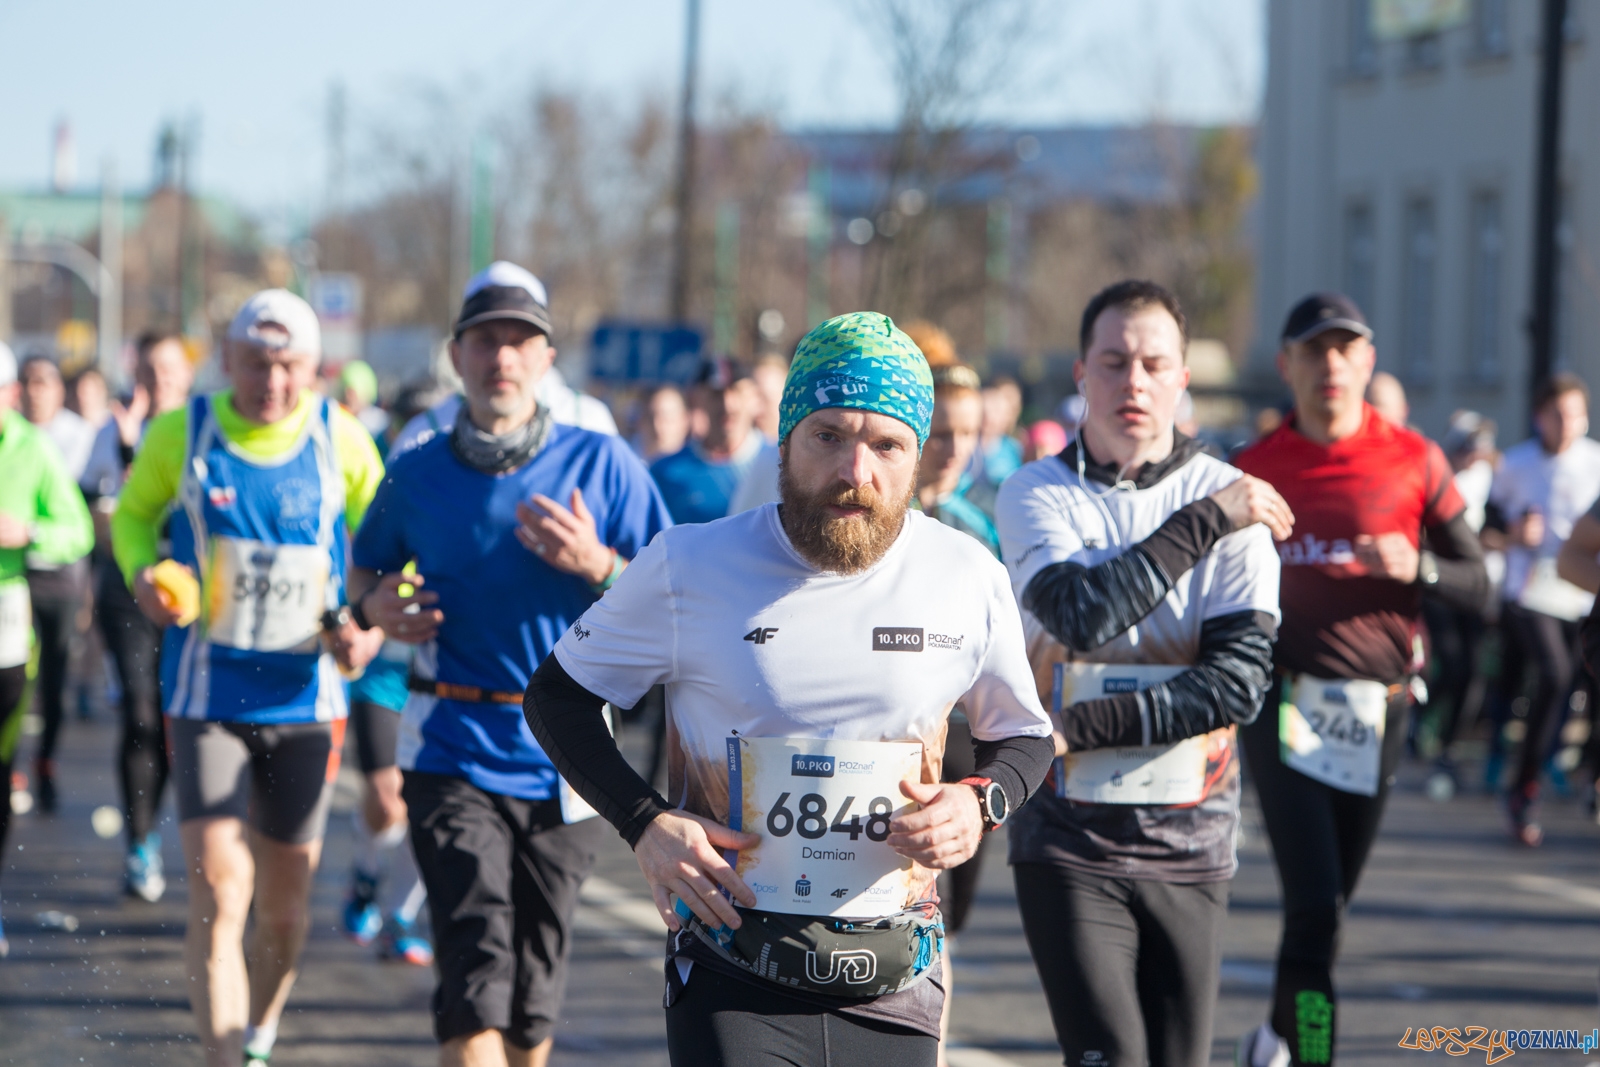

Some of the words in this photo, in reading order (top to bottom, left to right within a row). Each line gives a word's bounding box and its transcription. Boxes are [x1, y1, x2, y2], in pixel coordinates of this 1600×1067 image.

[816, 375, 870, 388] FOREST
[814, 383, 868, 405] run
[743, 627, 779, 644] 4F
[877, 633, 893, 645] 10.
[895, 634, 920, 645] PKO
[728, 743, 737, 772] 26.03.2017
[795, 760, 808, 771] 10.
[808, 761, 832, 772] PKO
[766, 792, 893, 842] 6848
[802, 847, 856, 861] Damian
[830, 888, 849, 898] 4F
